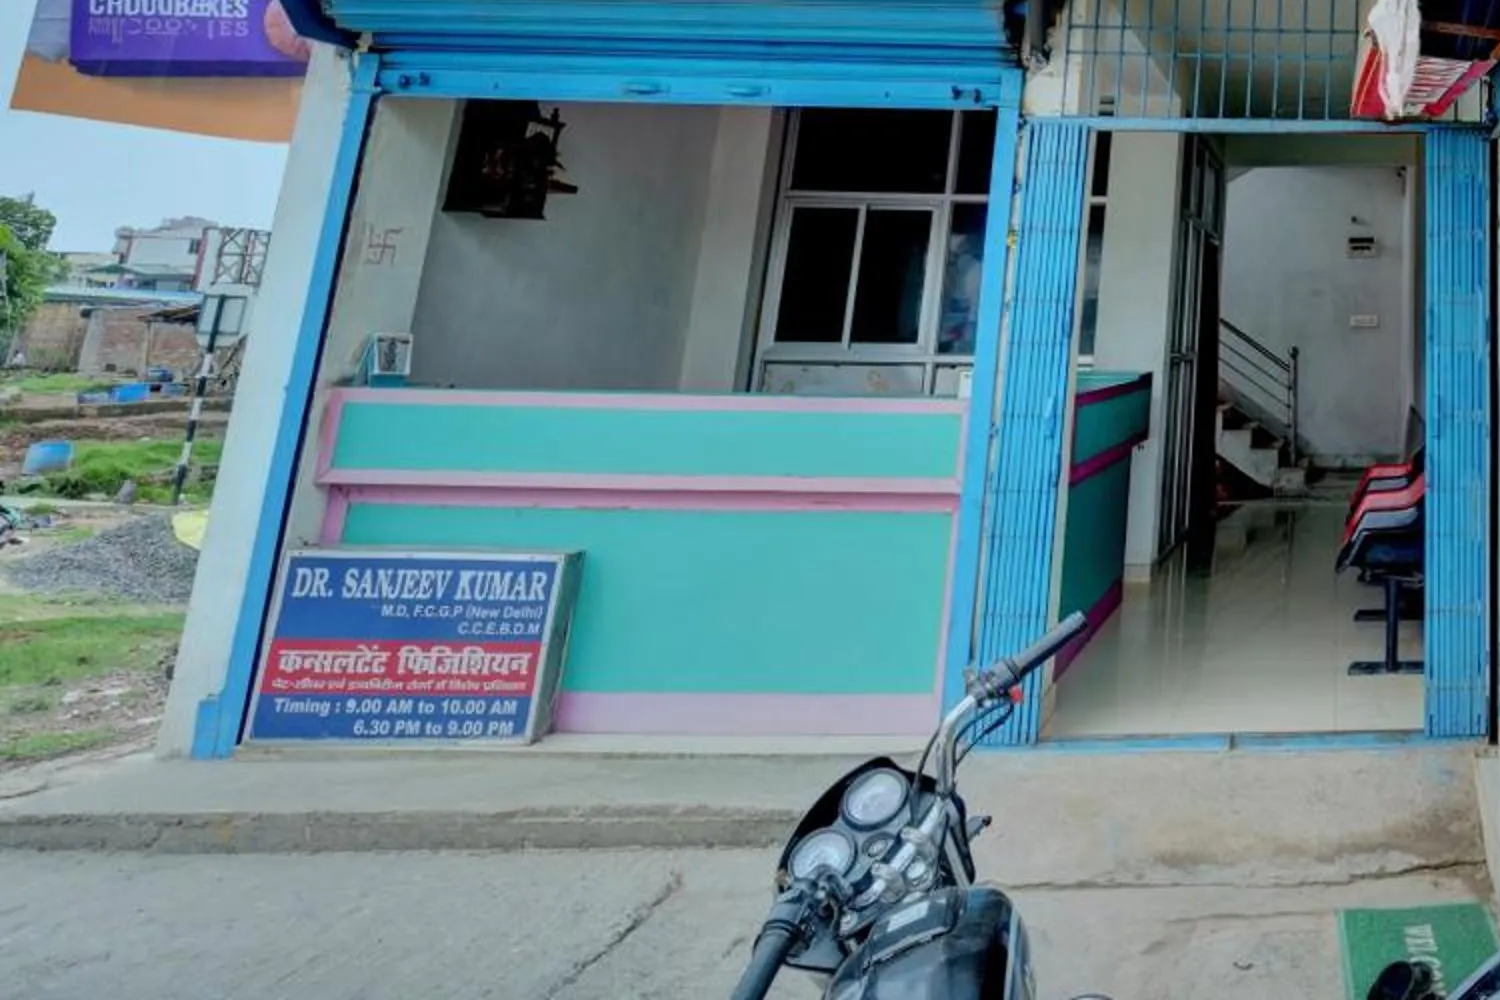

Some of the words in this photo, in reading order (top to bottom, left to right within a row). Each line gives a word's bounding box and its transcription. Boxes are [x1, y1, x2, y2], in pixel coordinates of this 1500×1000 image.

[291, 566, 334, 598] DR.
[341, 567, 451, 600] SANJEEV
[454, 570, 548, 602] KUMAR
[502, 604, 543, 621] Delhi)
[273, 697, 332, 716] Timing
[344, 699, 382, 715] 9.00
[386, 700, 413, 715] AM
[417, 700, 436, 716] to
[441, 699, 486, 716] 10.00
[488, 700, 517, 716] AM
[353, 719, 391, 736] 6.30
[393, 719, 421, 736] PM
[425, 720, 443, 736] to
[446, 720, 483, 737] 9.00
[486, 720, 515, 737] PM
